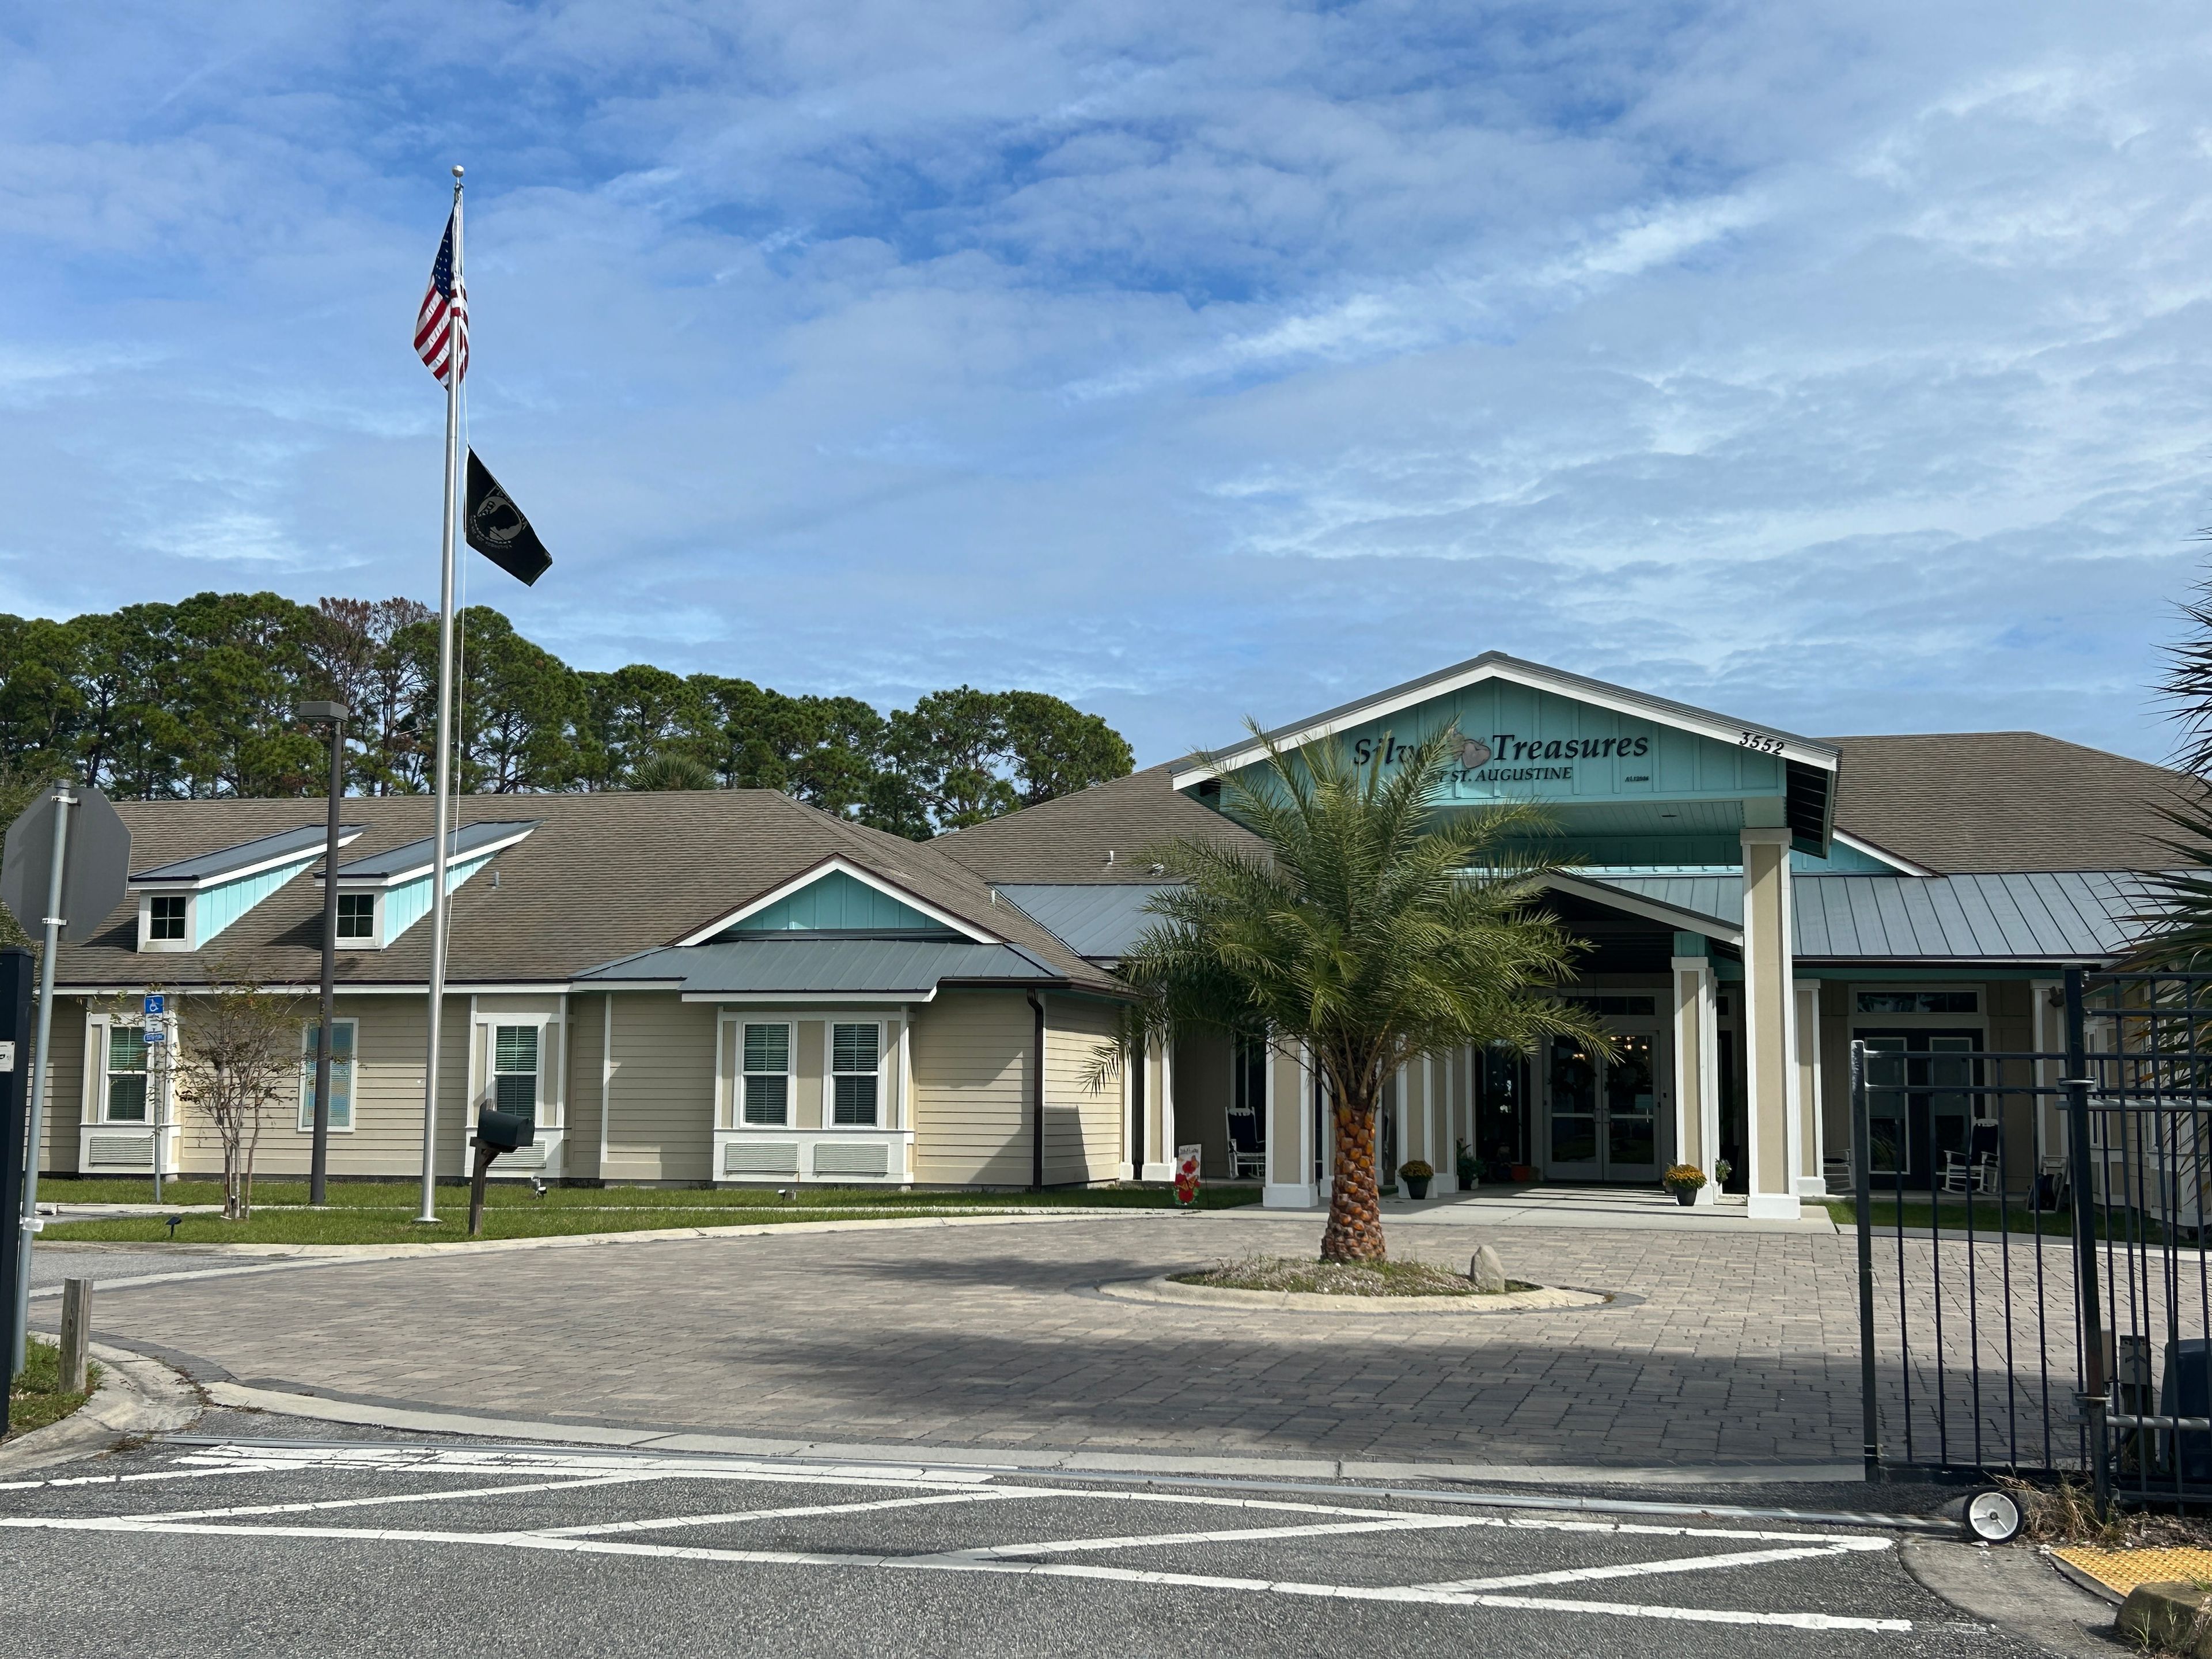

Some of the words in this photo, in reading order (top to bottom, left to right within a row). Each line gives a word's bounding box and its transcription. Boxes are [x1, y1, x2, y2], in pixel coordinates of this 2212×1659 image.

[1492, 734, 1649, 761] Treasures
[1738, 732, 1785, 756] 3552
[1450, 770, 1472, 782] ST.
[1475, 767, 1573, 782] AUGUSTINE
